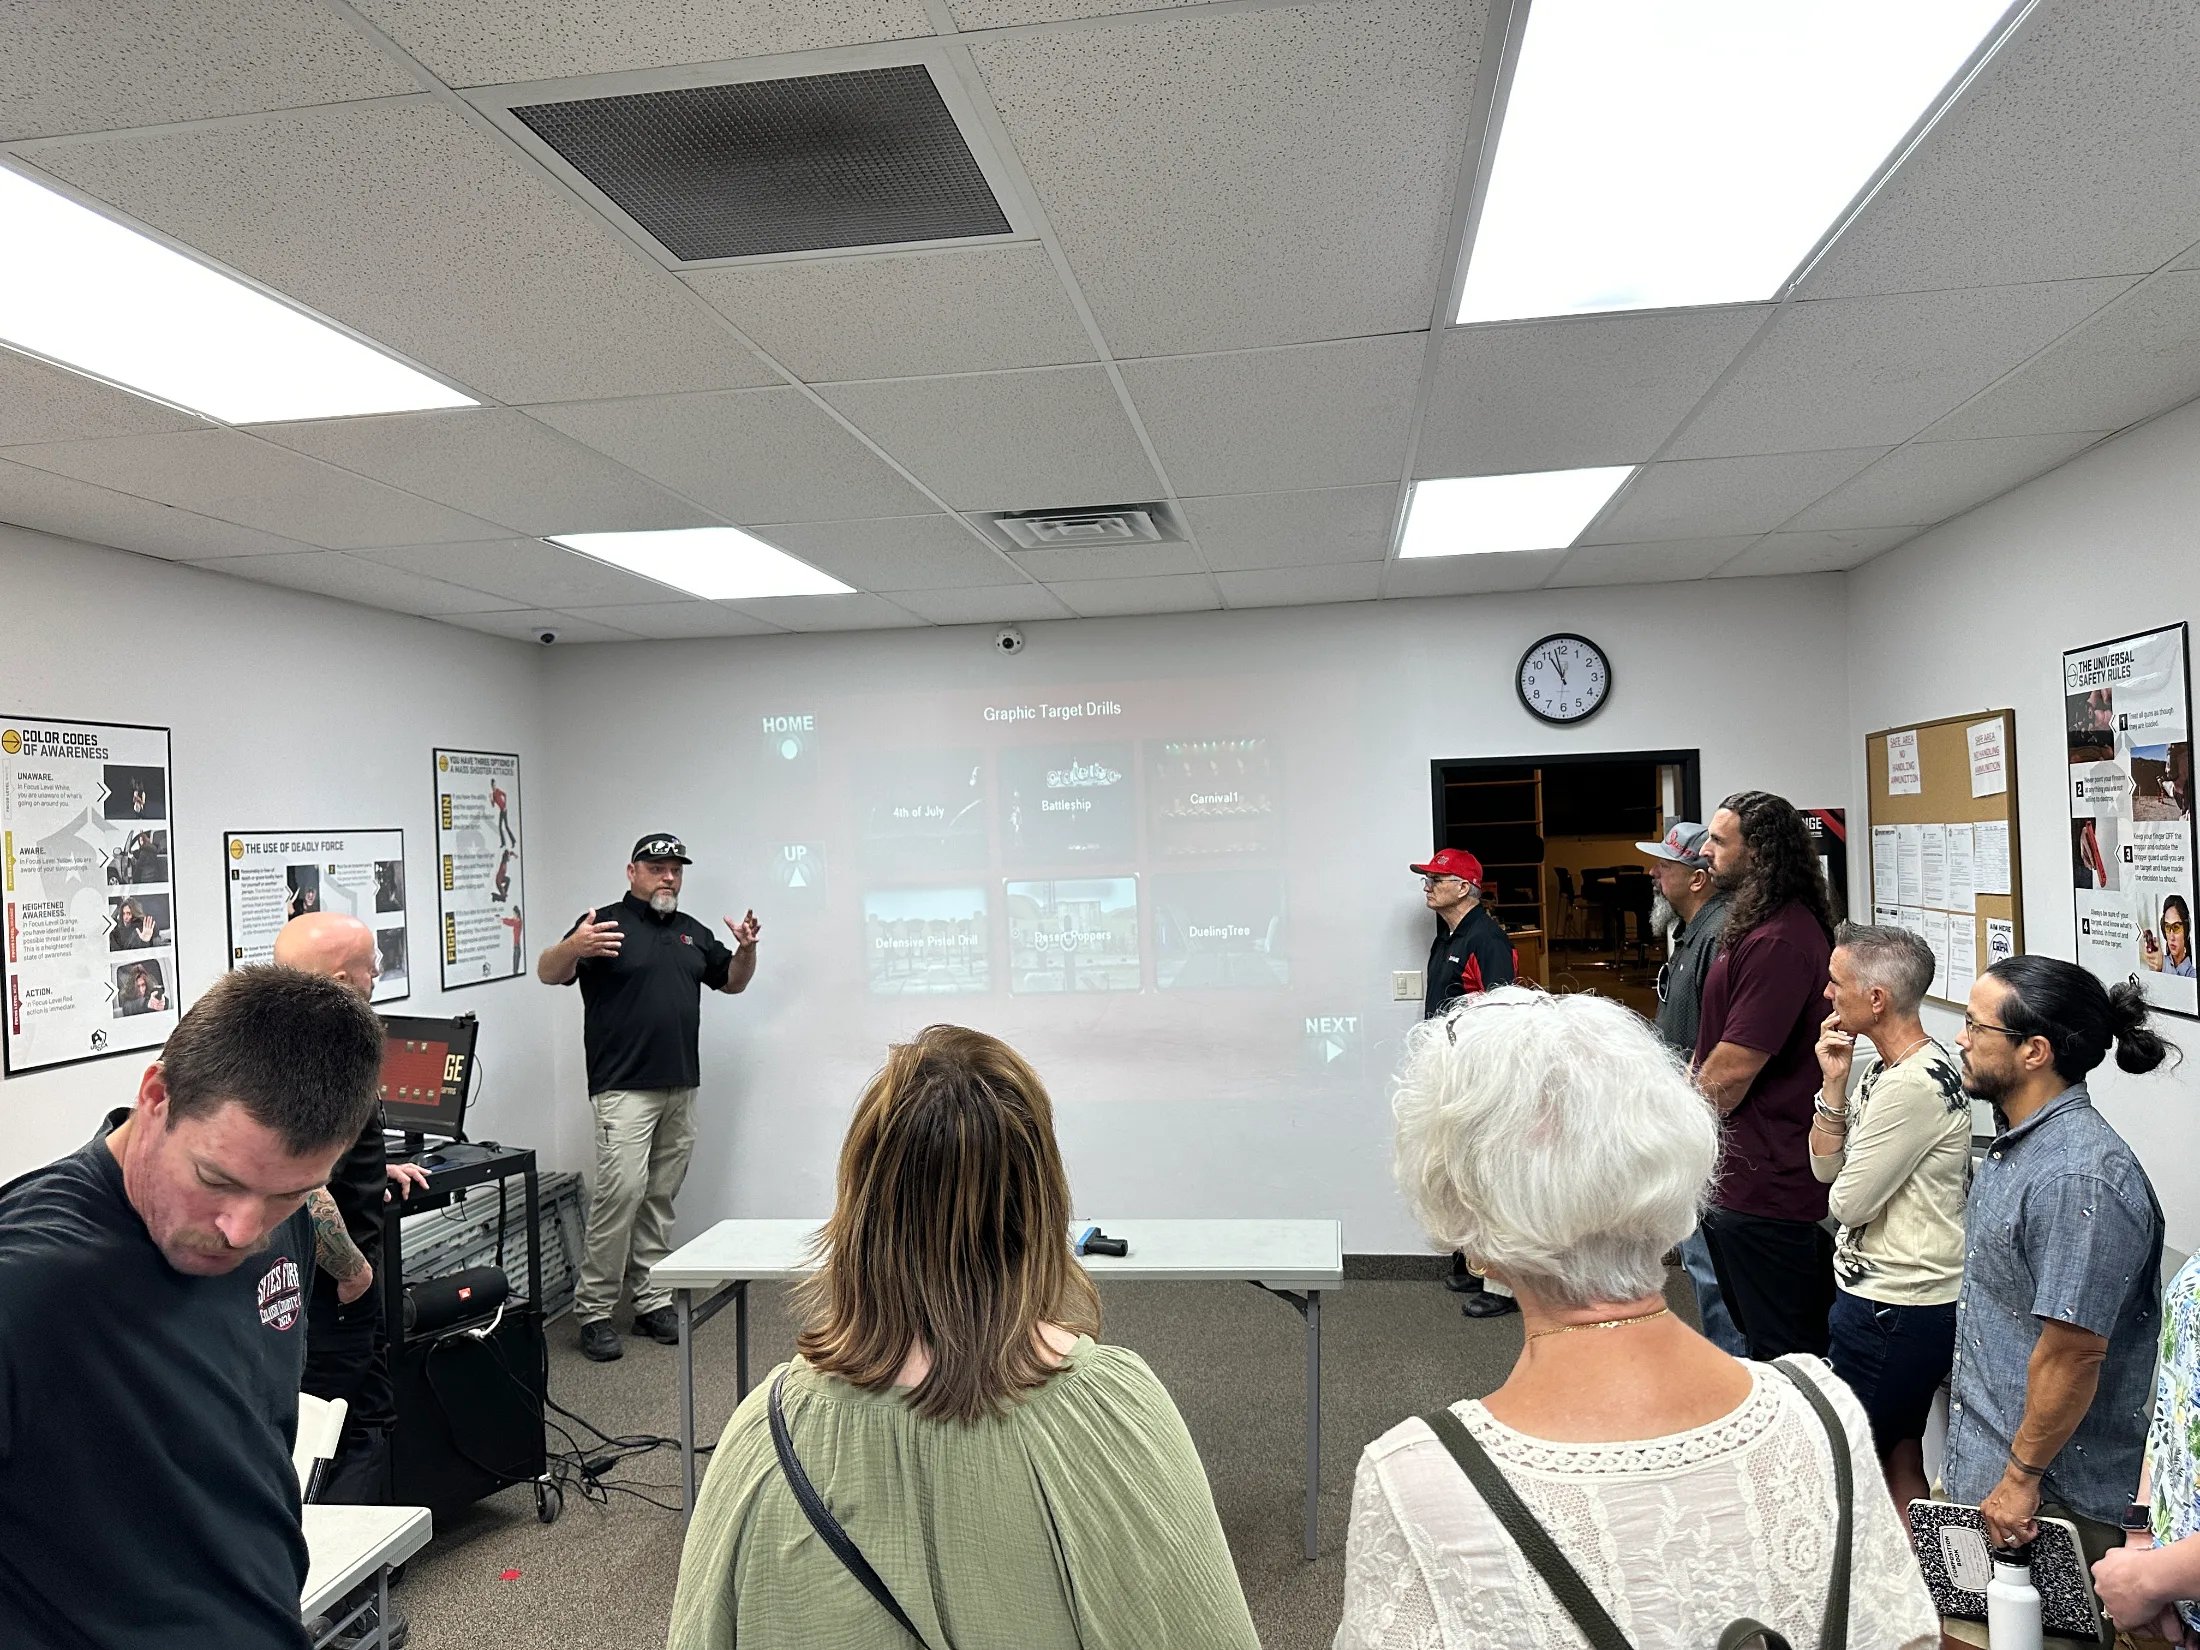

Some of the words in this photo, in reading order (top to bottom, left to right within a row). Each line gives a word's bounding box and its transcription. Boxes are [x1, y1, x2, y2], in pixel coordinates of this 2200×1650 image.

[1542, 652, 1551, 660] 11
[1557, 646, 1567, 655] 12
[1575, 650, 1579, 658] 1
[1532, 661, 1542, 670] 10
[1586, 658, 1592, 667] 2
[2078, 659, 2092, 673] THE
[2094, 650, 2134, 670] UNIVERSAL
[1528, 676, 1535, 685] 9
[1591, 673, 1598, 682] 3
[2079, 670, 2106, 687] SAFETY
[2108, 665, 2130, 681] RULES
[1533, 690, 1540, 699] 8
[1587, 687, 1593, 696] 4
[1546, 700, 1552, 708] 7
[1560, 703, 1567, 712] 6
[1576, 698, 1582, 707] 5
[984, 706, 1036, 723] Graphic
[1039, 704, 1083, 720] Target
[1086, 701, 1121, 716] Drills
[762, 715, 814, 732] HOME
[2122, 716, 2125, 728] 1
[23, 730, 59, 744] COLOR
[63, 733, 97, 746] CODES
[1890, 736, 1900, 746] SAFE
[1902, 735, 1914, 744] AREA
[1975, 735, 1984, 744] SAFE
[1984, 732, 1995, 742] AREA
[24, 744, 37, 756] OF
[41, 745, 108, 759] AWARENESS
[1899, 750, 1905, 758] NO
[1892, 761, 1914, 772] HANDLING
[18, 772, 54, 781] UNAWARE.
[1891, 774, 1918, 784] AMMUNITION
[2078, 784, 2082, 795] 2
[1190, 792, 1238, 805] Carnival1
[1042, 798, 1092, 813] Battleship
[443, 797, 451, 829] RUN
[893, 807, 909, 818] 4th
[912, 806, 921, 817] of
[925, 805, 944, 819] July
[246, 843, 261, 854] THE
[263, 843, 278, 853] USE
[280, 842, 290, 853] OF
[292, 841, 319, 852] DEADLY
[321, 841, 344, 851] FORCE
[784, 845, 807, 861] UP
[2126, 848, 2130, 860] 3
[444, 856, 453, 889] HIDE
[22, 901, 64, 911] HEIGHTENED
[22, 909, 67, 919] AWARENESS.
[1190, 925, 1250, 939] DuelingTree
[2084, 921, 2088, 932] 4
[446, 917, 456, 961] FIGHT
[876, 937, 924, 948] Defensive
[928, 935, 955, 946] Pistol
[958, 934, 978, 946] Drill
[1034, 931, 1069, 943] Desert
[1071, 930, 1111, 944] Poppers
[26, 987, 53, 998] ACTION.
[1306, 1016, 1357, 1033] NEXT
